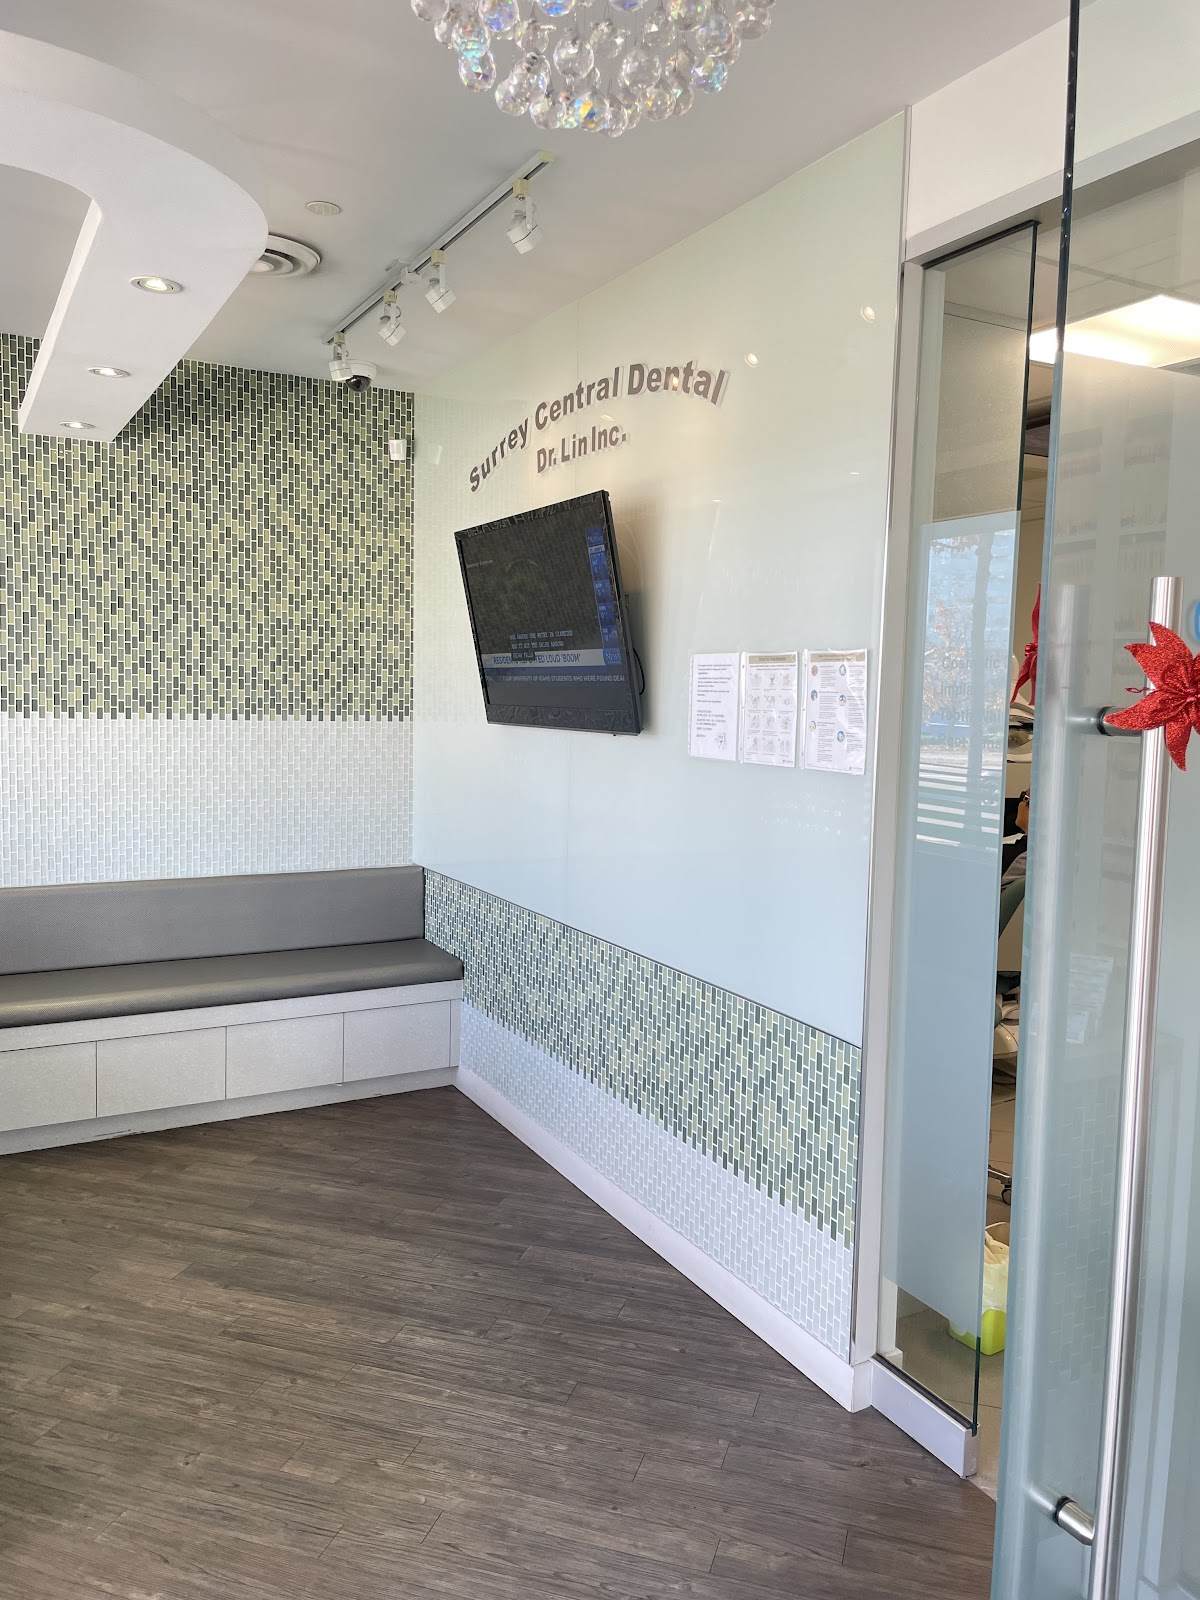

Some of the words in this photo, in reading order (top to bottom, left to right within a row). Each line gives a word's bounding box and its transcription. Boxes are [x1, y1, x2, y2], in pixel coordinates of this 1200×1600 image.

[469, 417, 530, 493] Surrey
[535, 366, 620, 431] Central
[627, 360, 727, 406] Dental
[537, 447, 557, 474] Dr.
[561, 433, 588, 463] Lin
[591, 425, 627, 453] Inc.
[545, 653, 561, 663] LOUD
[561, 652, 580, 663] 'BOOM'
[605, 651, 622, 661] NEWS
[942, 656, 1001, 670] Costic
